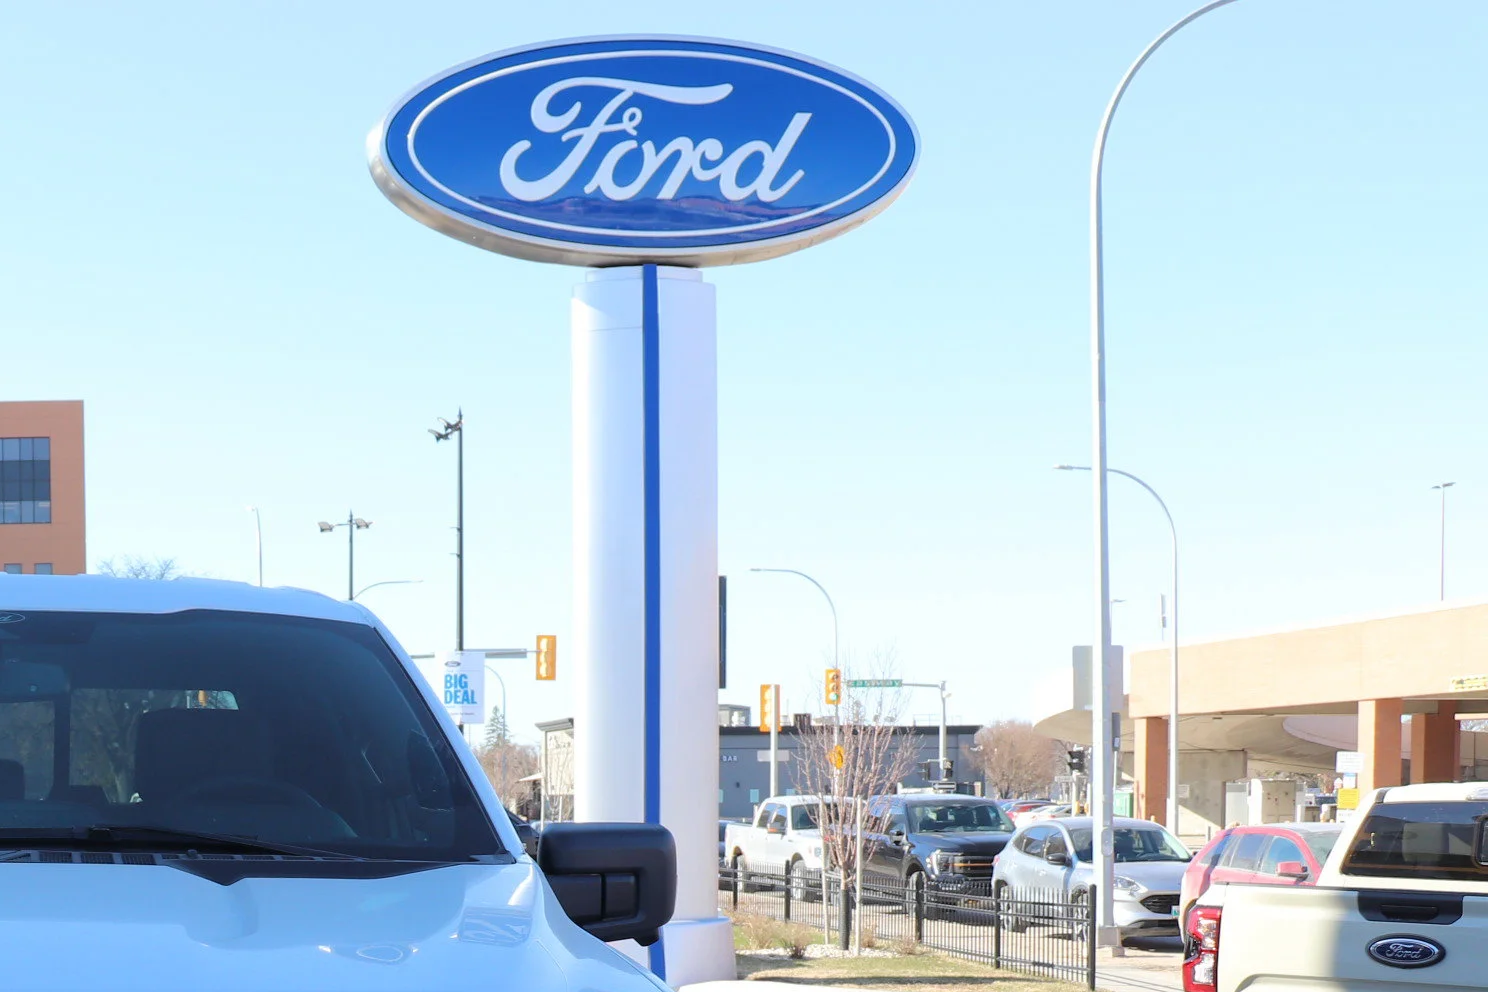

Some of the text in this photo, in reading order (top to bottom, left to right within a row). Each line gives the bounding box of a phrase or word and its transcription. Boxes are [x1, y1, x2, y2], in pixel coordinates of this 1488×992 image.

[499, 76, 813, 202] Ford
[444, 673, 468, 689] BIG
[444, 689, 477, 705] DEAL
[1385, 943, 1423, 959] Ford
